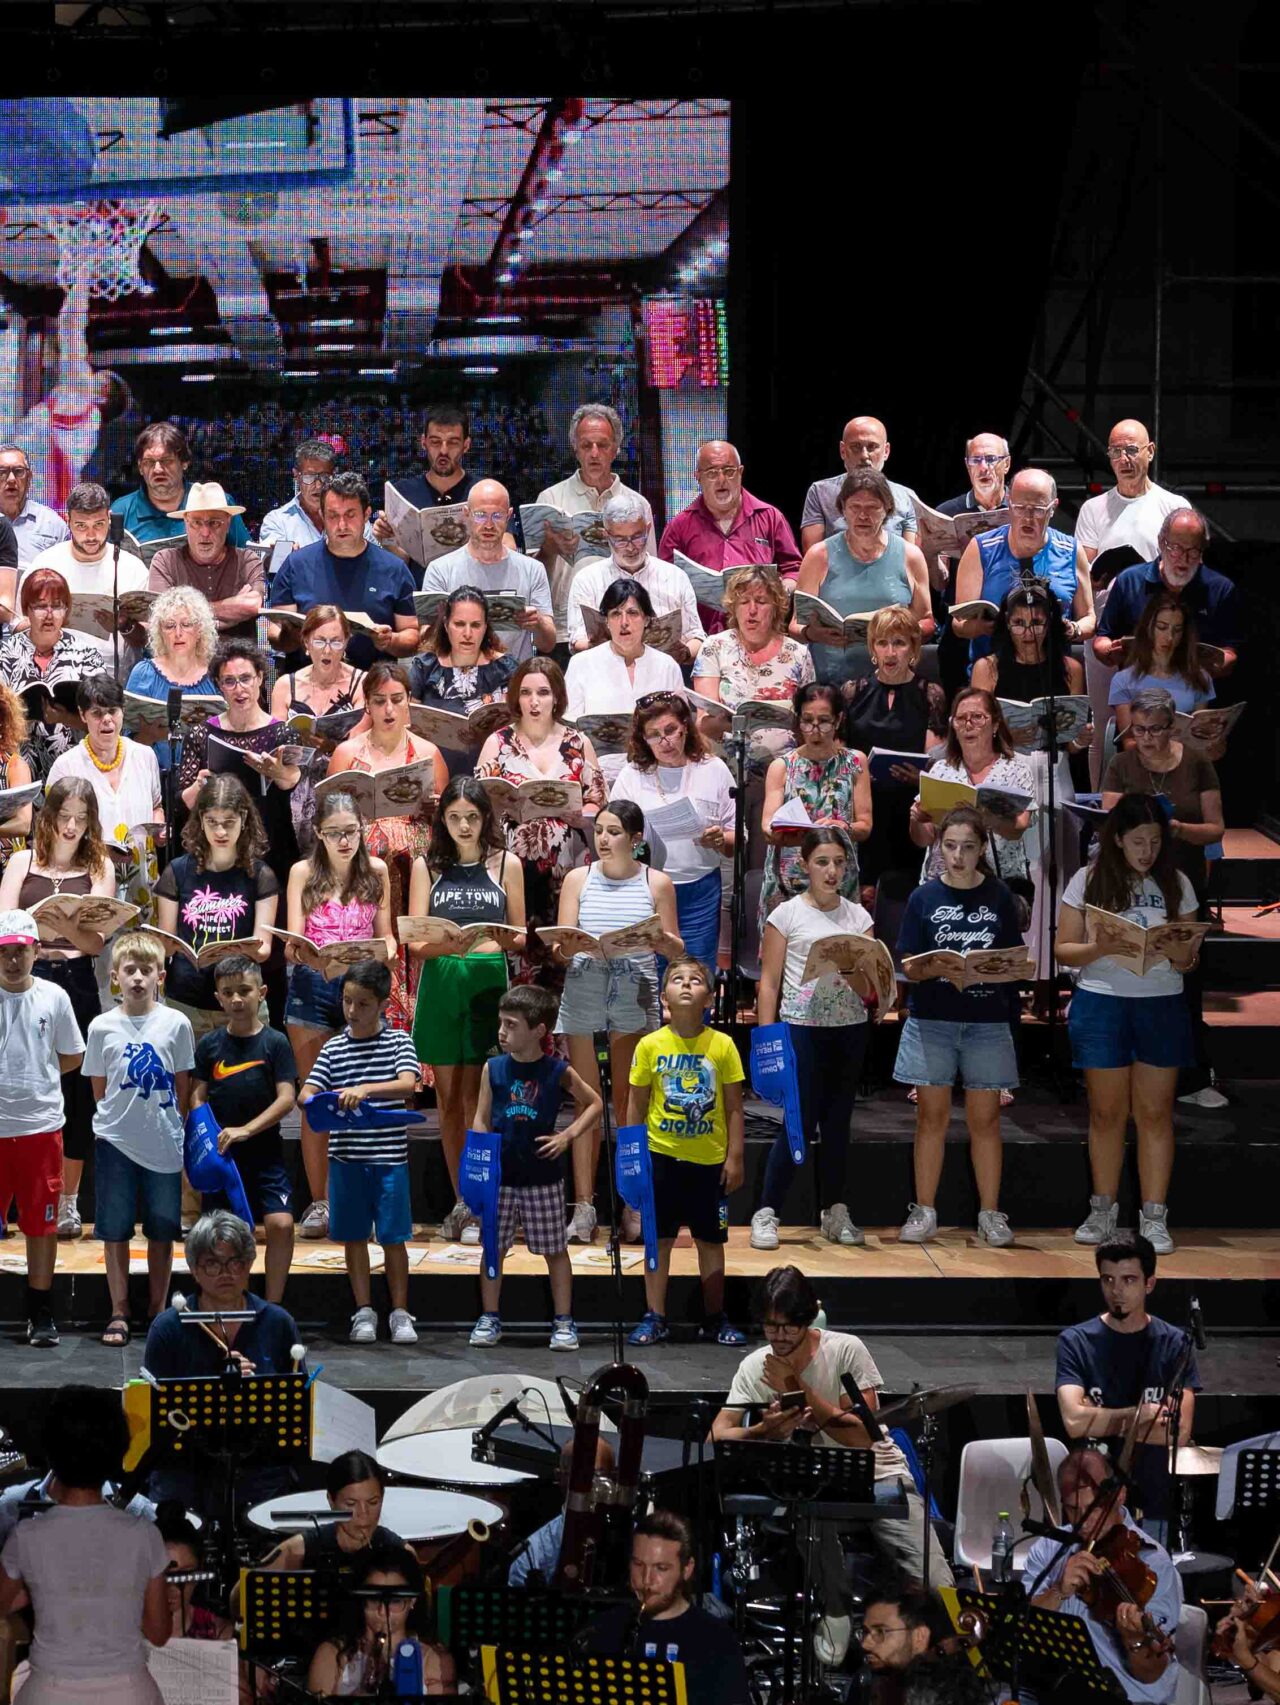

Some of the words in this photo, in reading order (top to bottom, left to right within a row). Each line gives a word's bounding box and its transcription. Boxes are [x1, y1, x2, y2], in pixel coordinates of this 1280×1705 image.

[434, 891, 462, 908] CAPE
[466, 891, 499, 908] TOWN
[930, 904, 964, 923] The
[967, 905, 997, 923] Sea
[199, 924, 231, 933] PERFECT
[934, 924, 995, 949] Everyday
[657, 1053, 705, 1072] DUNE
